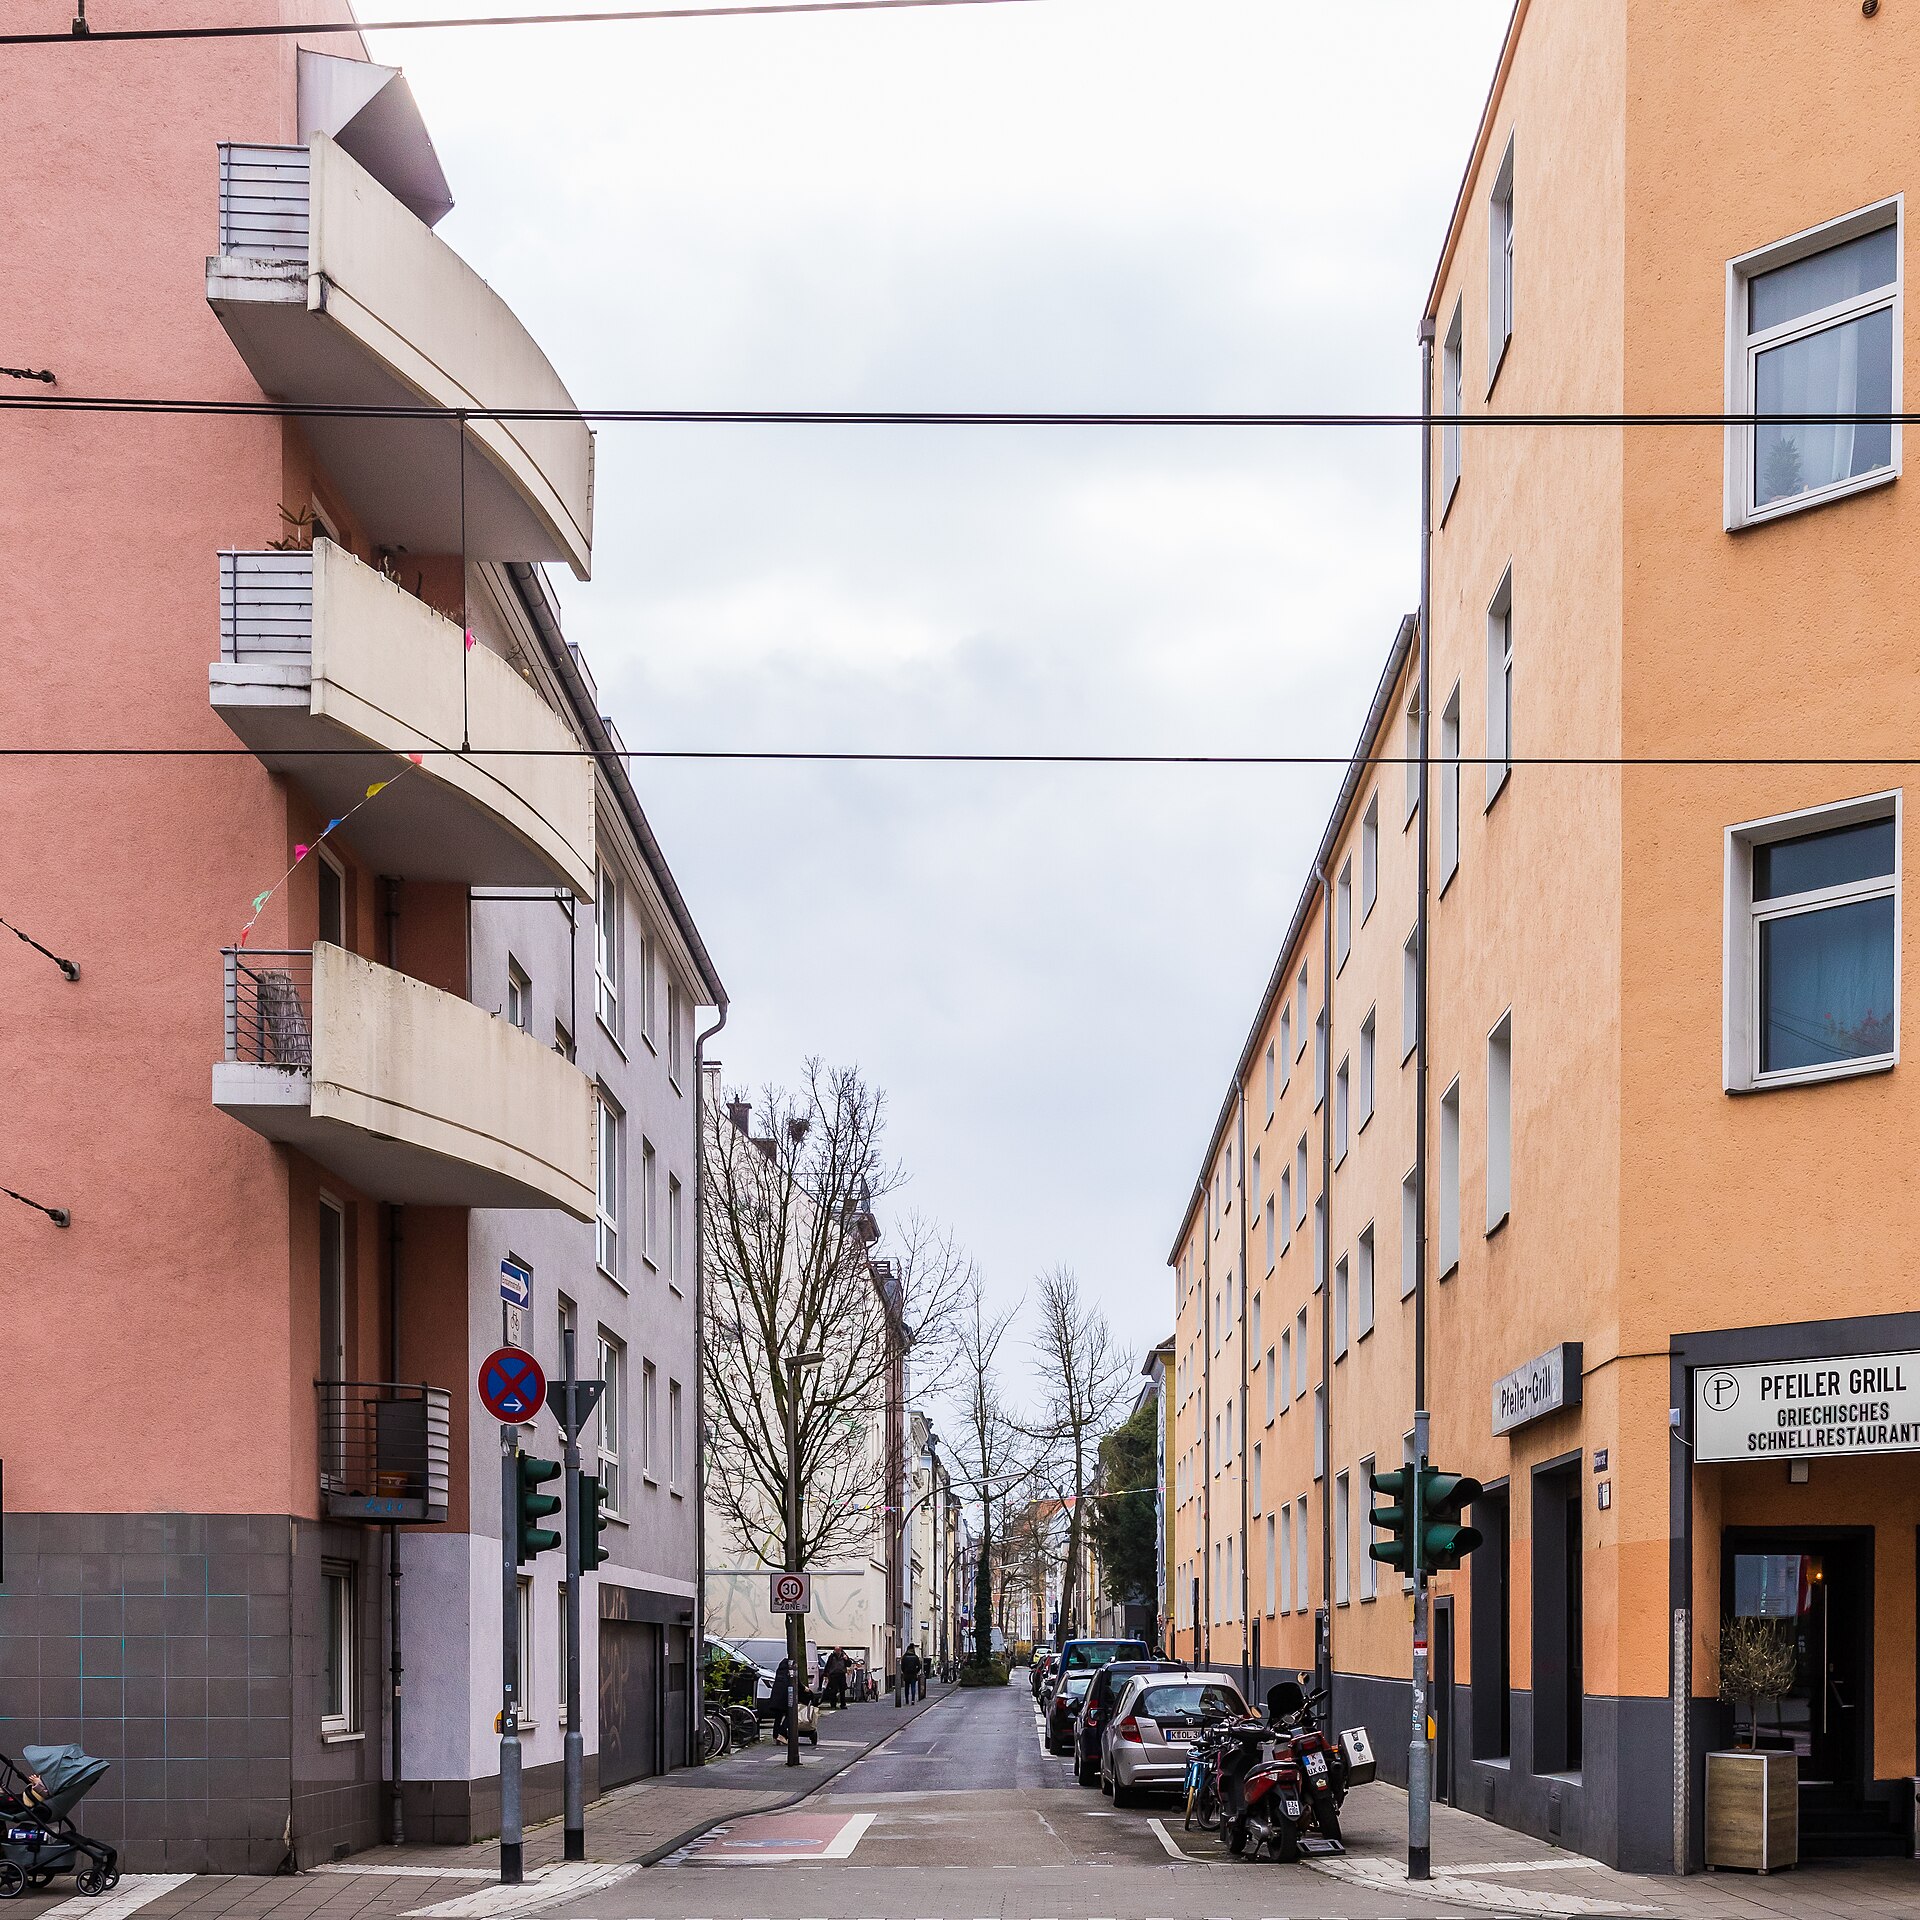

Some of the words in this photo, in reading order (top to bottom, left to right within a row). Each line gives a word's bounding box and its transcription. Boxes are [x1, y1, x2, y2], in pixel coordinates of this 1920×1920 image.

[1501, 1364, 1551, 1419] Pfeiler-Grill
[1760, 1371, 1841, 1401] PFEILER
[1849, 1366, 1907, 1395] GRILL
[1777, 1401, 1889, 1427] GRIECHISCHES
[1747, 1423, 1920, 1451] SCHNELLRESTAURANT
[783, 1583, 798, 1595] 30
[1171, 1731, 1177, 1739] K
[1318, 1764, 1327, 1772] 69
